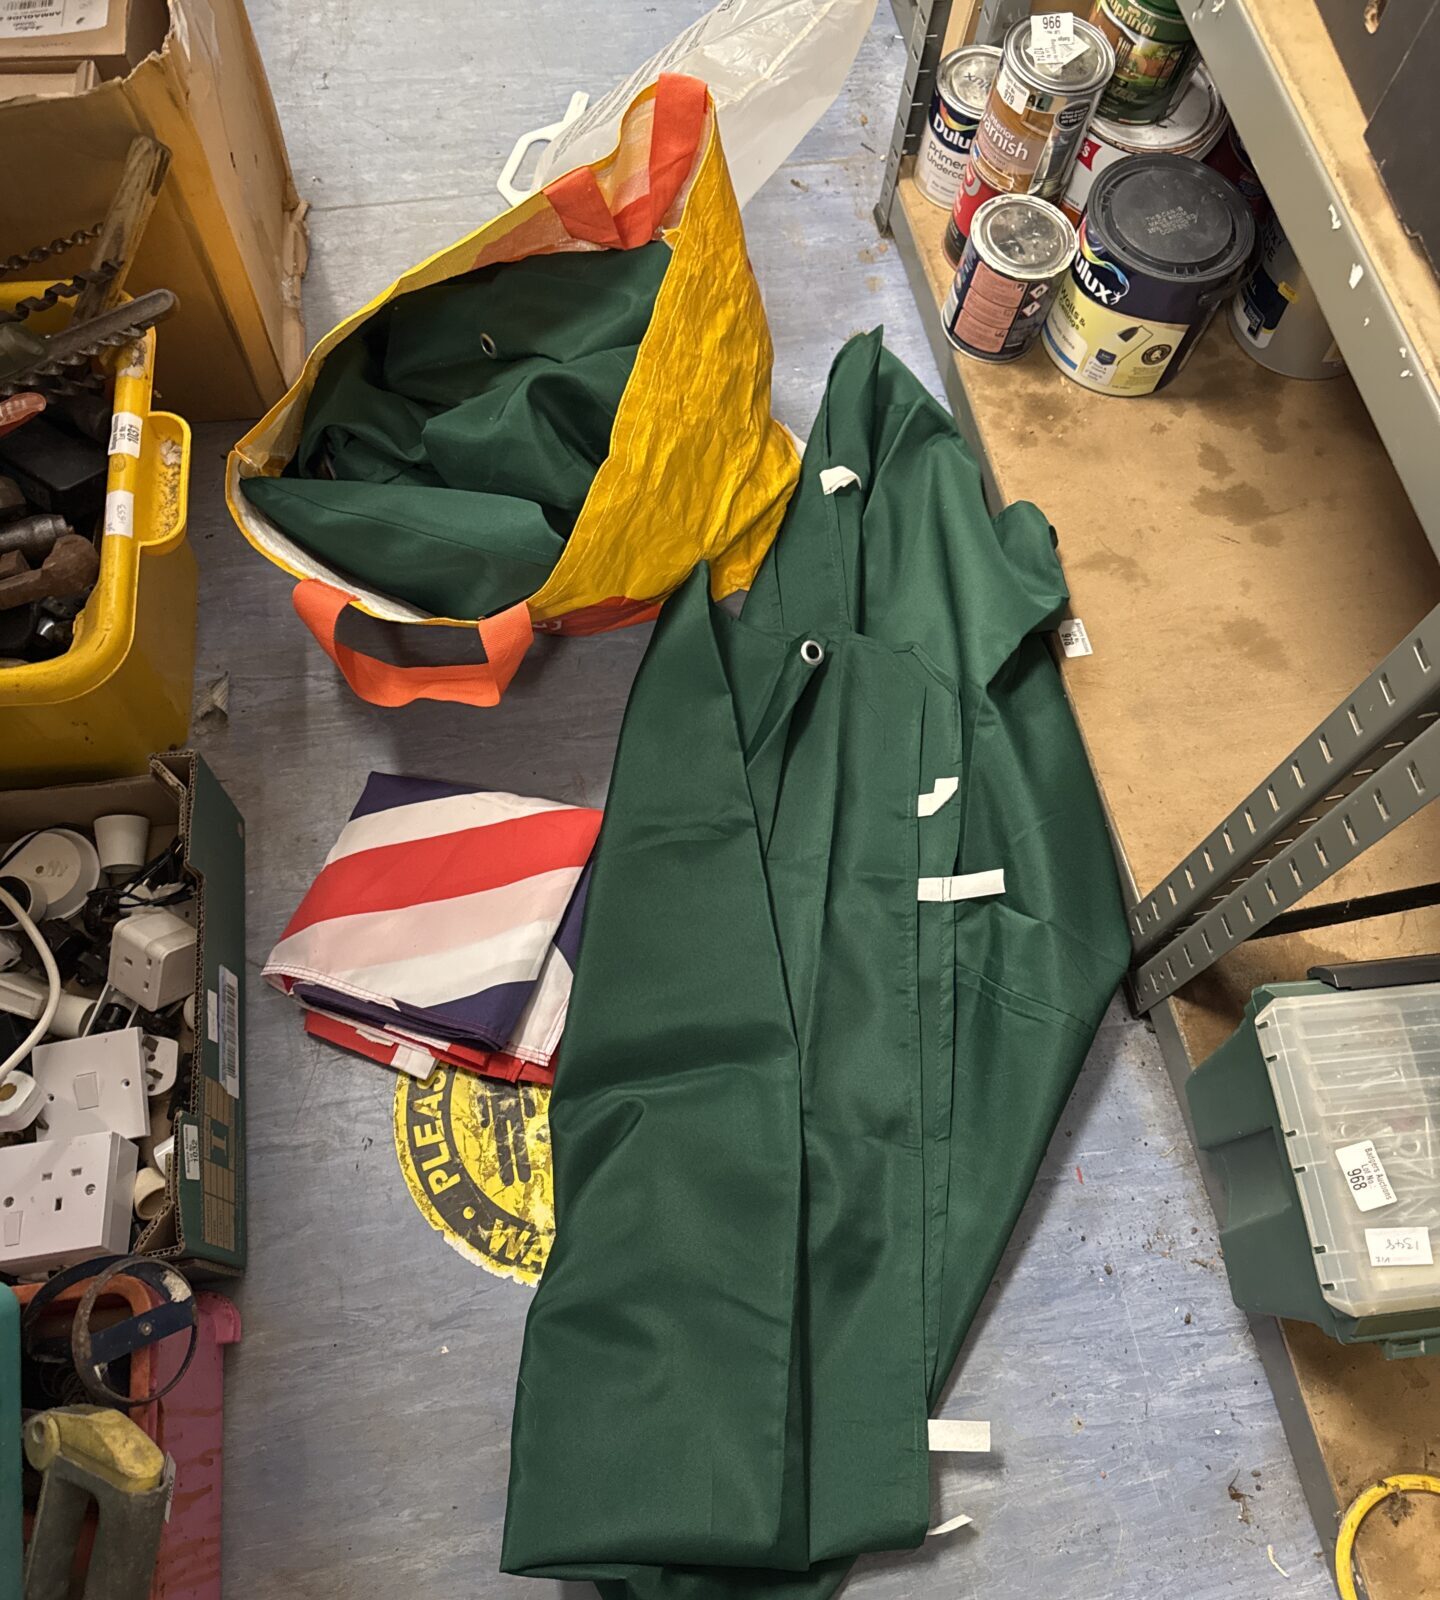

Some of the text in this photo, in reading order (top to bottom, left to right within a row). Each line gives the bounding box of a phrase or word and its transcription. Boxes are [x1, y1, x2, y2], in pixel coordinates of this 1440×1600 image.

[1108, 0, 1157, 37] uprinol
[933, 112, 973, 150] Dulu
[927, 151, 965, 181] Underco
[928, 140, 967, 170] Primer
[1060, 286, 1080, 322] Walls
[413, 1063, 461, 1196] PLEAS
[1347, 1168, 1368, 1191] 968
[1361, 1163, 1372, 1176] Lot
[1364, 1147, 1392, 1201] Badgers Auctions
[489, 1217, 551, 1269] WA
